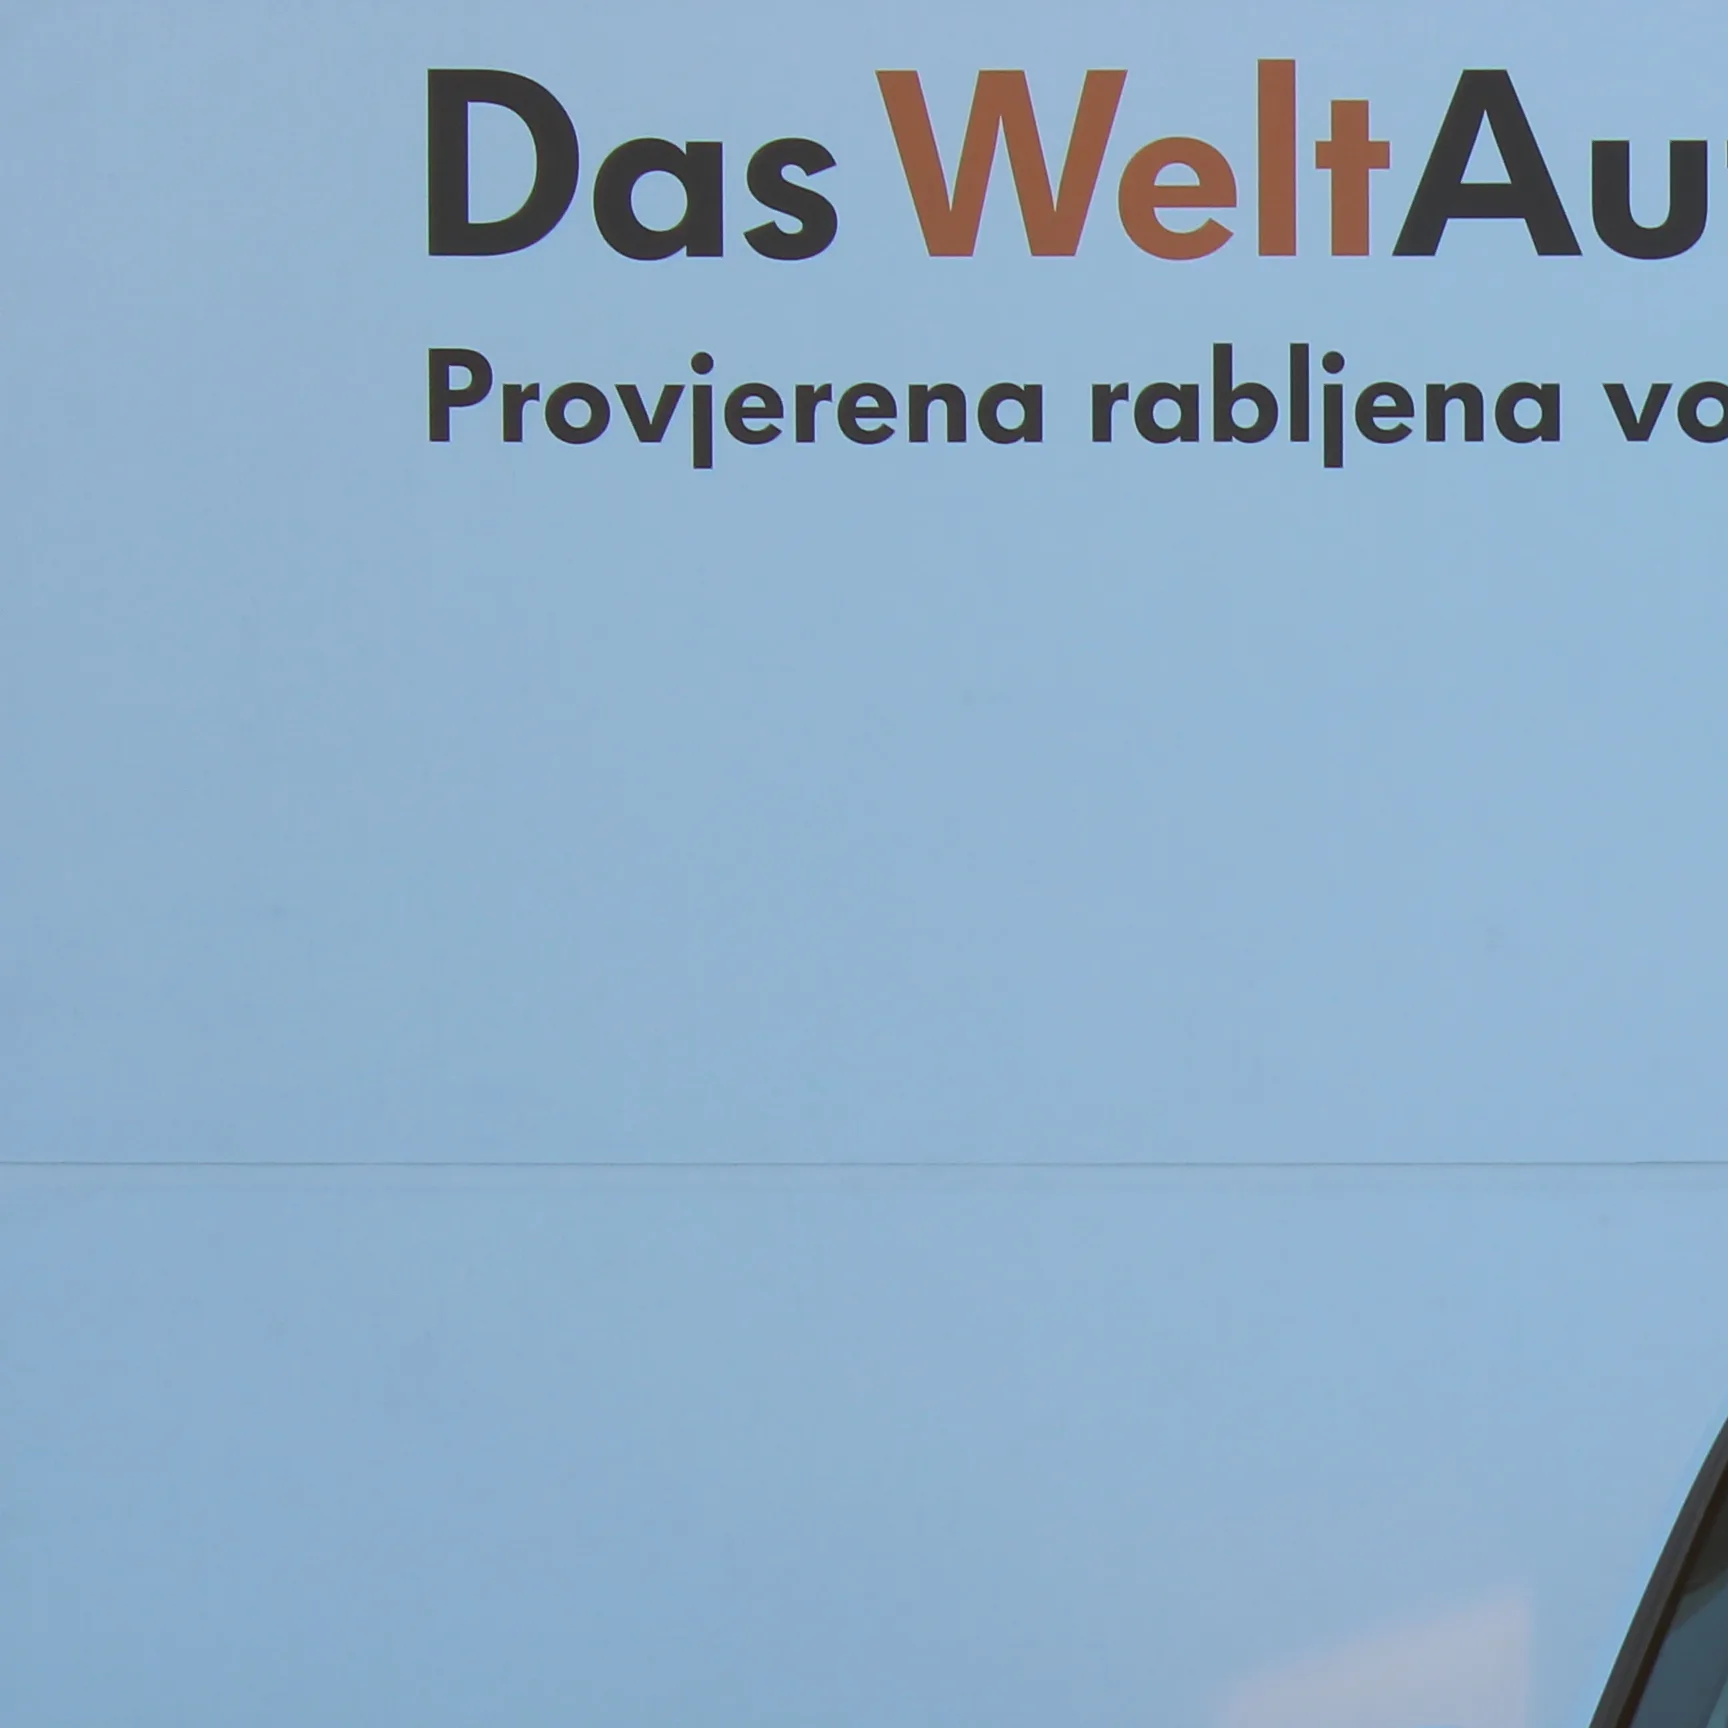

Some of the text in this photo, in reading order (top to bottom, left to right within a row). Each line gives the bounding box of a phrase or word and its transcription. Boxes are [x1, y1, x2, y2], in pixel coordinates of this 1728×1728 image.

[427, 68, 838, 261] Das
[428, 347, 1043, 470] Provjerena
[1091, 342, 1561, 469] rabljena
